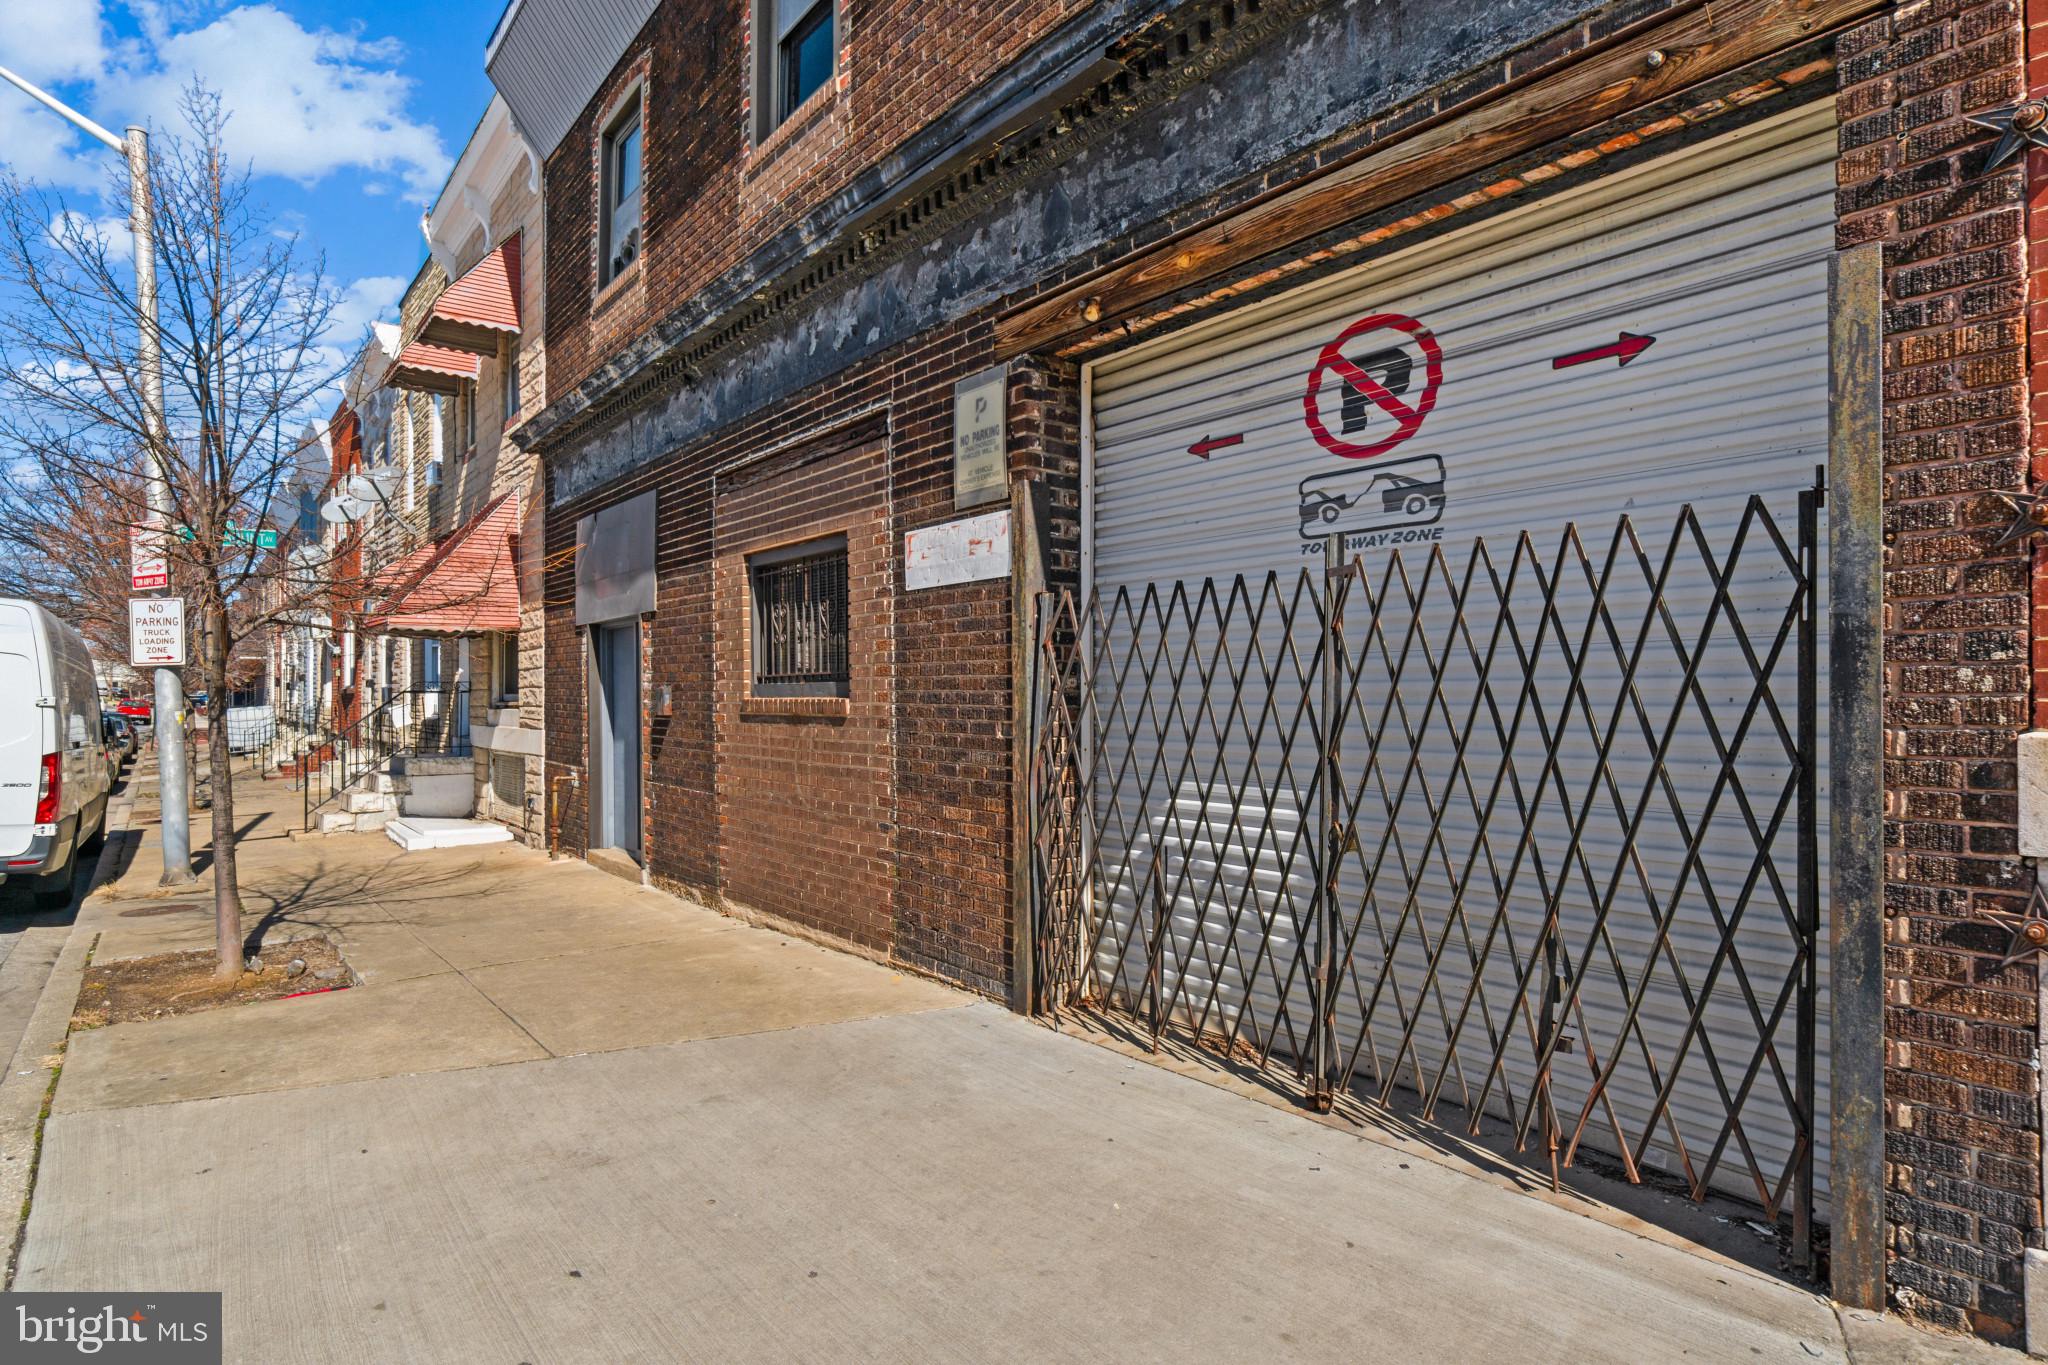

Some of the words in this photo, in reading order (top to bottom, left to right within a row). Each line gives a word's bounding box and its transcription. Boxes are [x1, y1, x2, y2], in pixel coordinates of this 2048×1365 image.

[960, 434, 970, 448] NO
[972, 424, 1000, 443] PARKING
[1390, 527, 1445, 545] ZONE
[148, 603, 164, 613] NO
[135, 616, 179, 627] PARKING
[139, 637, 175, 645] LOADING
[146, 646, 168, 654] ZONE
